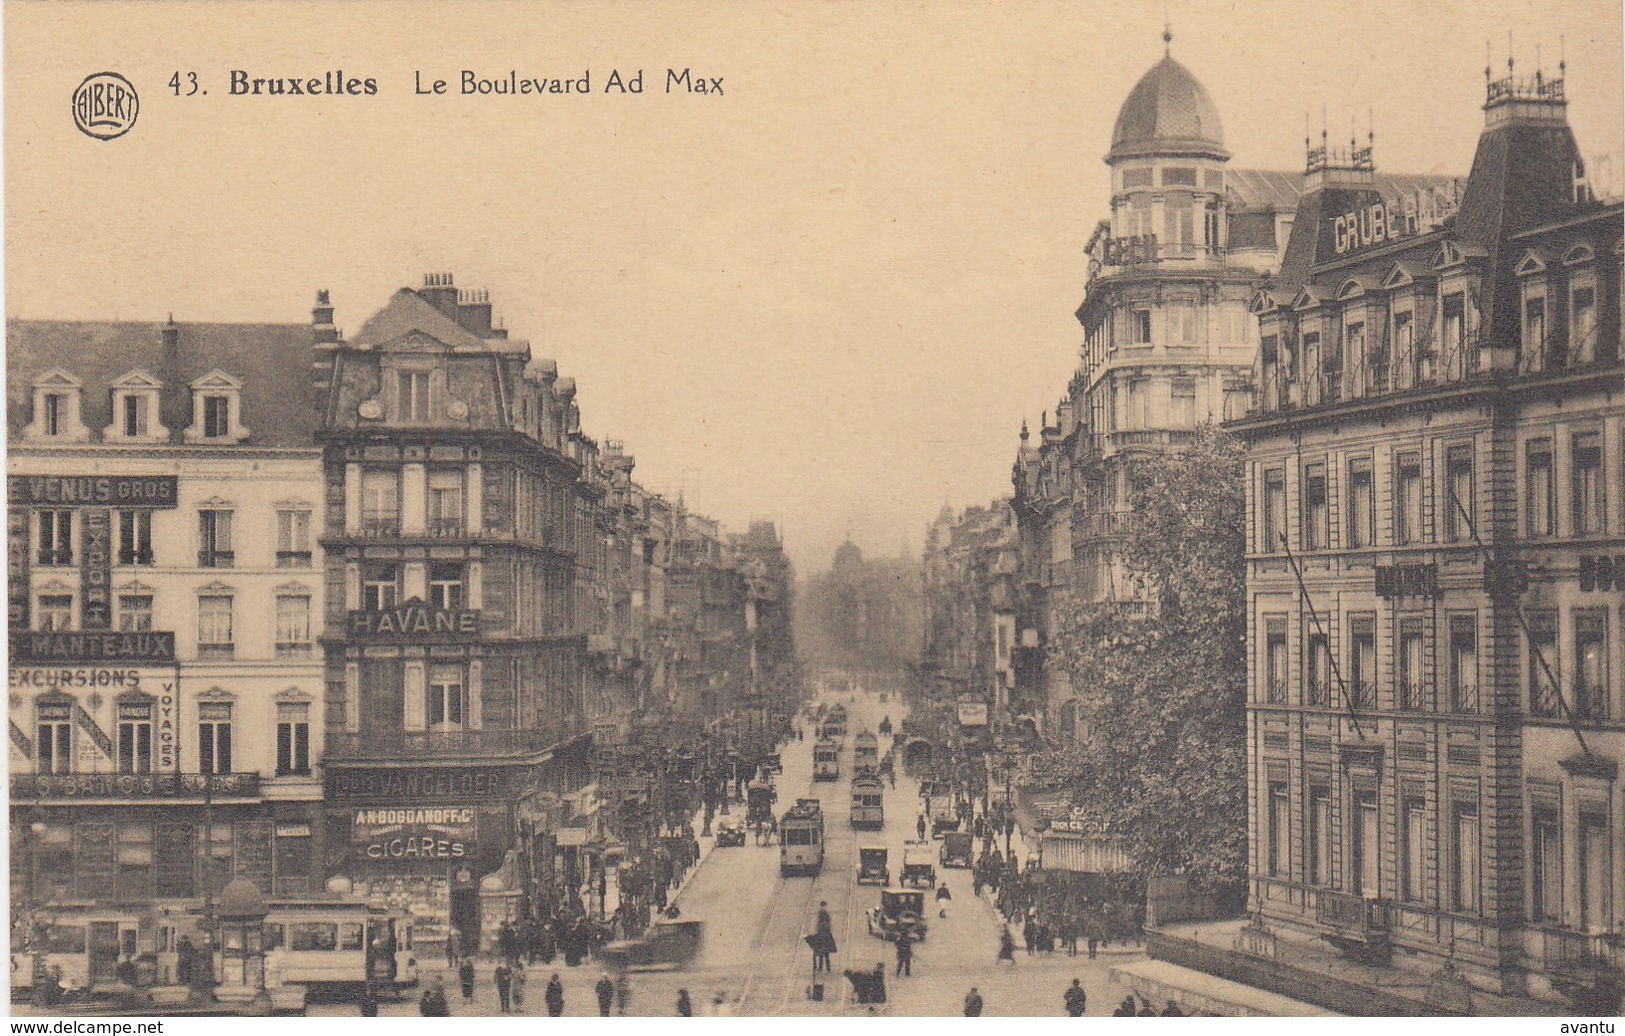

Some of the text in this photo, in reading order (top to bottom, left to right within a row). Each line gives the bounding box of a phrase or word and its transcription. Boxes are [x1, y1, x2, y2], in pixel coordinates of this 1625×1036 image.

[30, 477, 111, 500] VENUS
[356, 607, 477, 633] HAVANE
[31, 635, 171, 657] MANTEAUX
[9, 669, 140, 687] EXCURSIONS
[161, 682, 173, 767] VOYAGES
[367, 836, 465, 859] CIGARES
